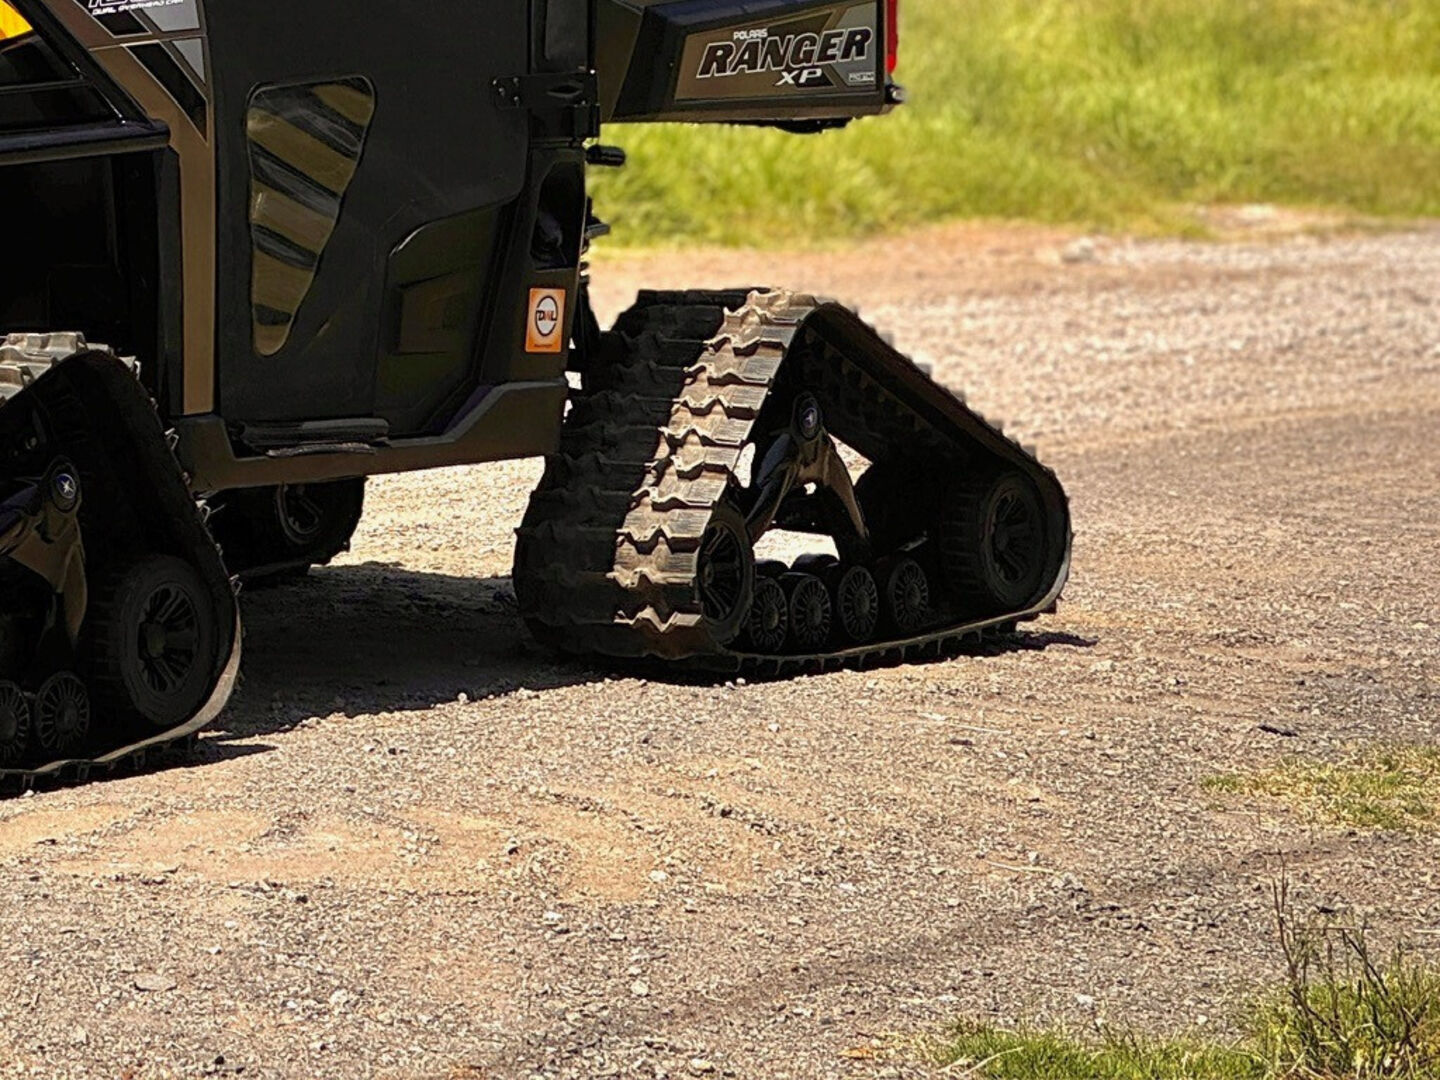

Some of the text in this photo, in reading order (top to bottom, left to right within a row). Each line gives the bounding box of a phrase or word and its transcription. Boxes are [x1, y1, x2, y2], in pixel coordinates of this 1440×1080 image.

[733, 28, 768, 40] POLARIS
[695, 26, 873, 78] RANGER
[775, 69, 823, 86] XP
